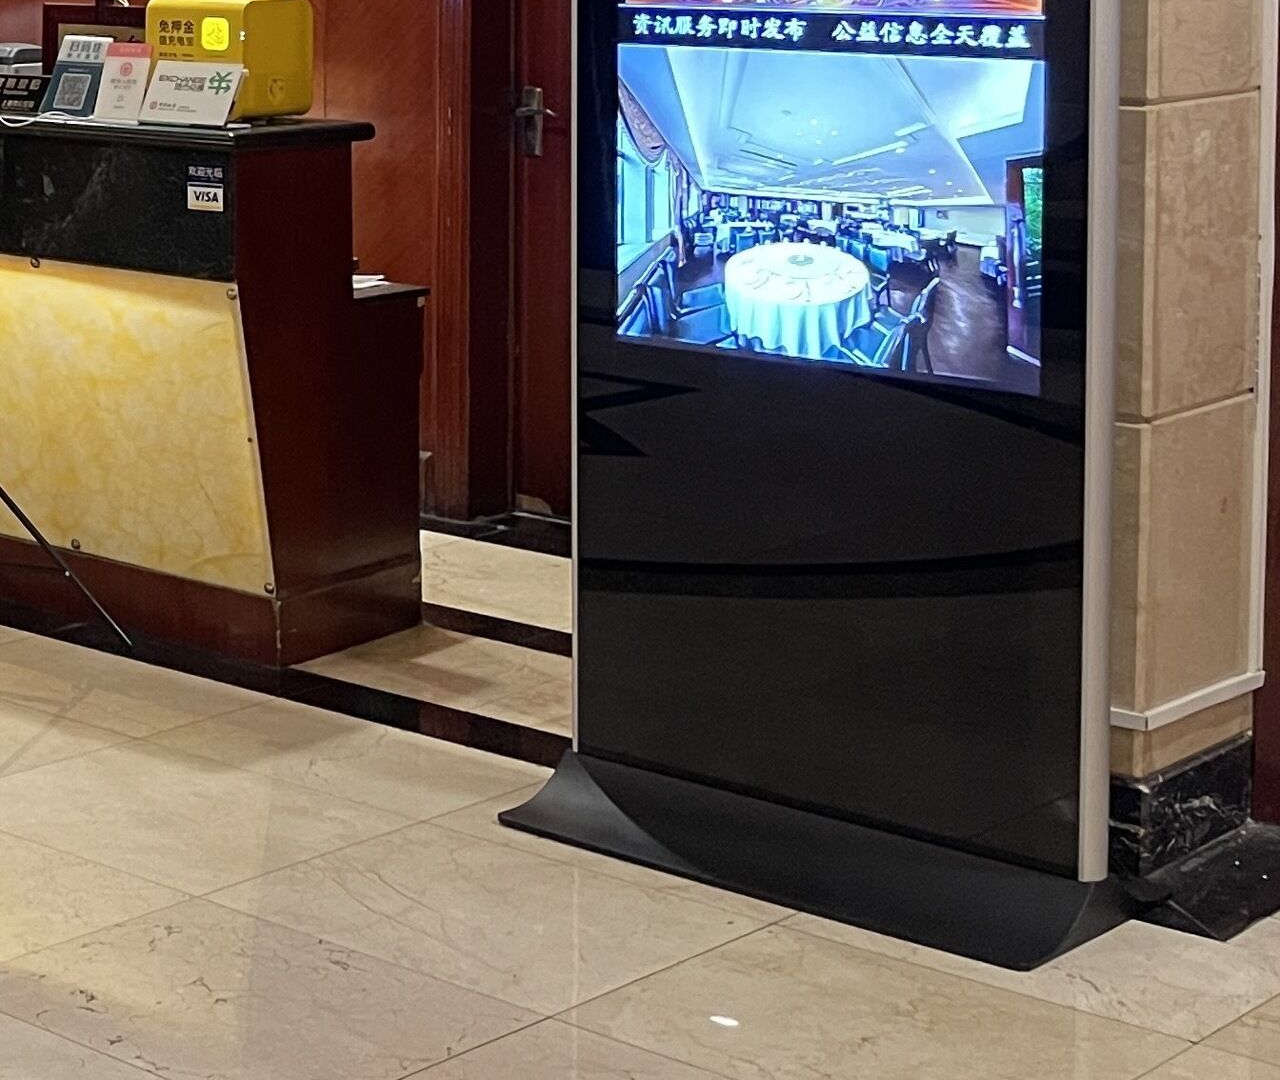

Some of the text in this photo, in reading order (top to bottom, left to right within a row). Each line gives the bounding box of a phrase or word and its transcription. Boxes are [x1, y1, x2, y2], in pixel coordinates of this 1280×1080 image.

[159, 20, 194, 34] 免押金
[632, 13, 1031, 49] 资讯服务即时发布 公益信息全天覆盖
[193, 191, 219, 203] VISA
